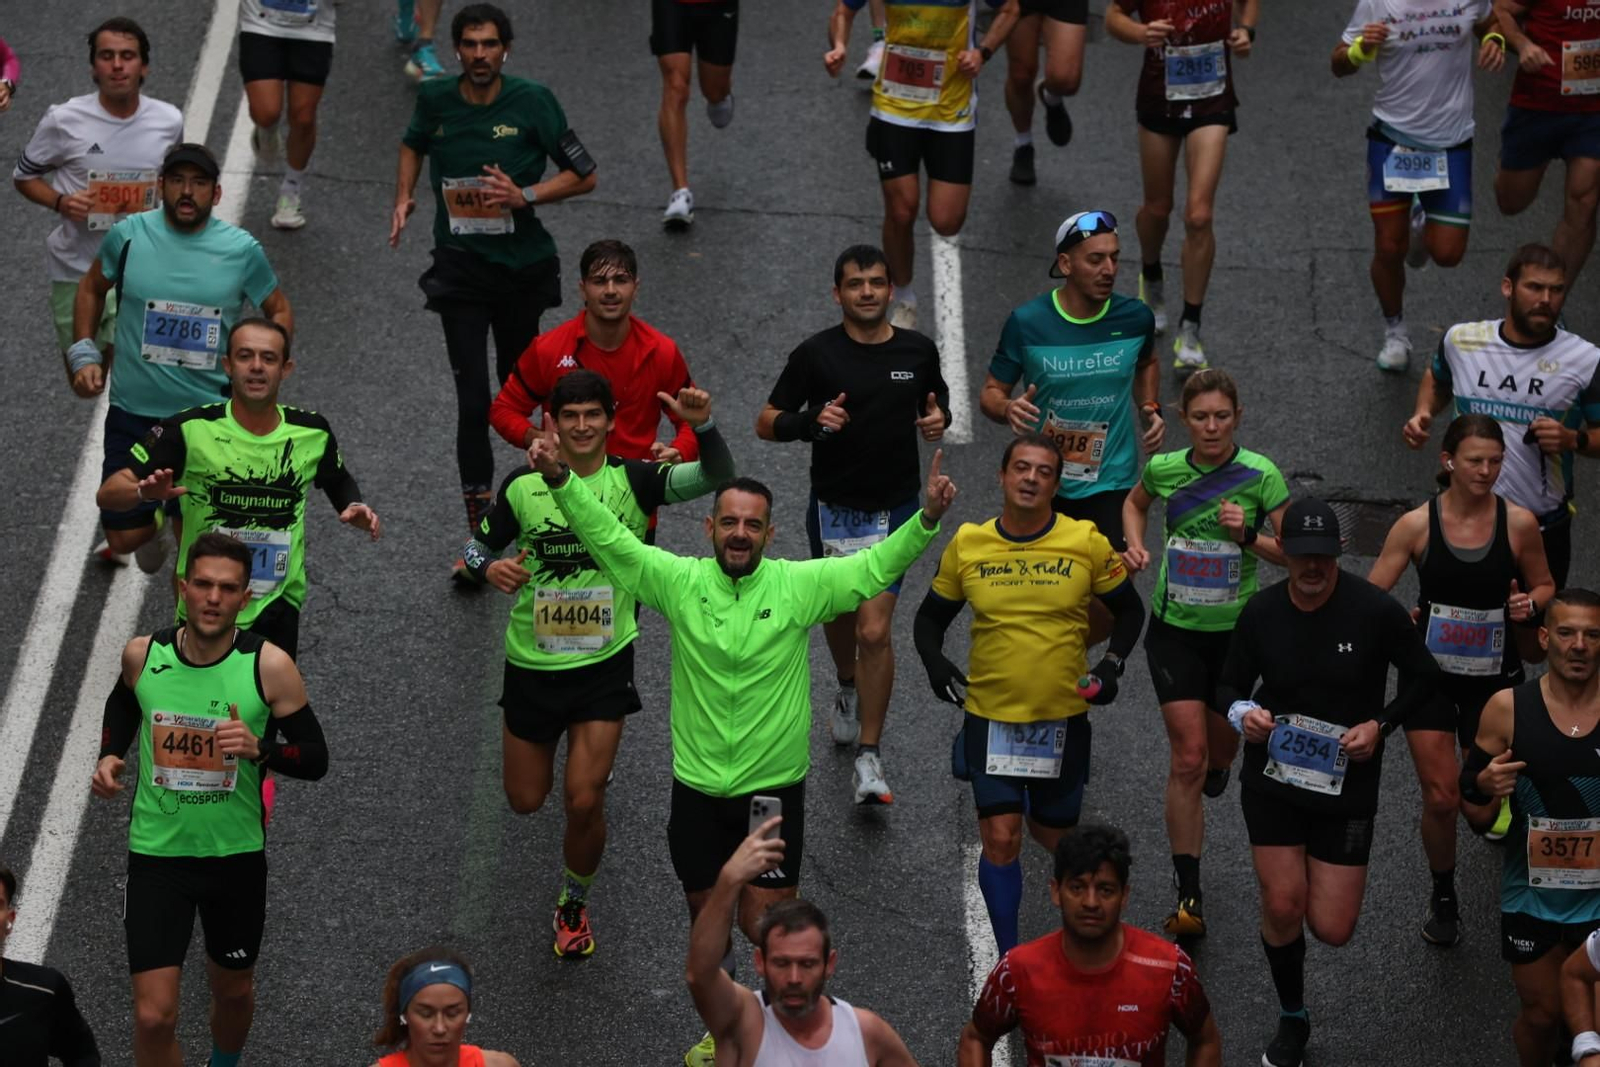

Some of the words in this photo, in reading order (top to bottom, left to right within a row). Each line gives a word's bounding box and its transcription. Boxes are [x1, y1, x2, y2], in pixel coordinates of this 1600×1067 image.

[899, 59, 925, 79] 705
[1176, 57, 1213, 77] 2815
[1394, 156, 1432, 171] 2998
[99, 186, 140, 204] 5301
[155, 316, 201, 341] 2786
[1043, 351, 1122, 372] NutreTec
[1477, 370, 1545, 396] LAR
[220, 490, 292, 510] tanynature
[830, 508, 875, 528] 2784
[1016, 559, 1034, 578] &
[1033, 556, 1075, 580] Field
[1177, 554, 1223, 578] 2223
[540, 604, 601, 625] 14404
[1438, 622, 1487, 648] 3009
[162, 731, 214, 758] 4461
[1280, 730, 1332, 761] 2554
[1540, 836, 1594, 858] 3577
[1513, 939, 1535, 948] VICKY
